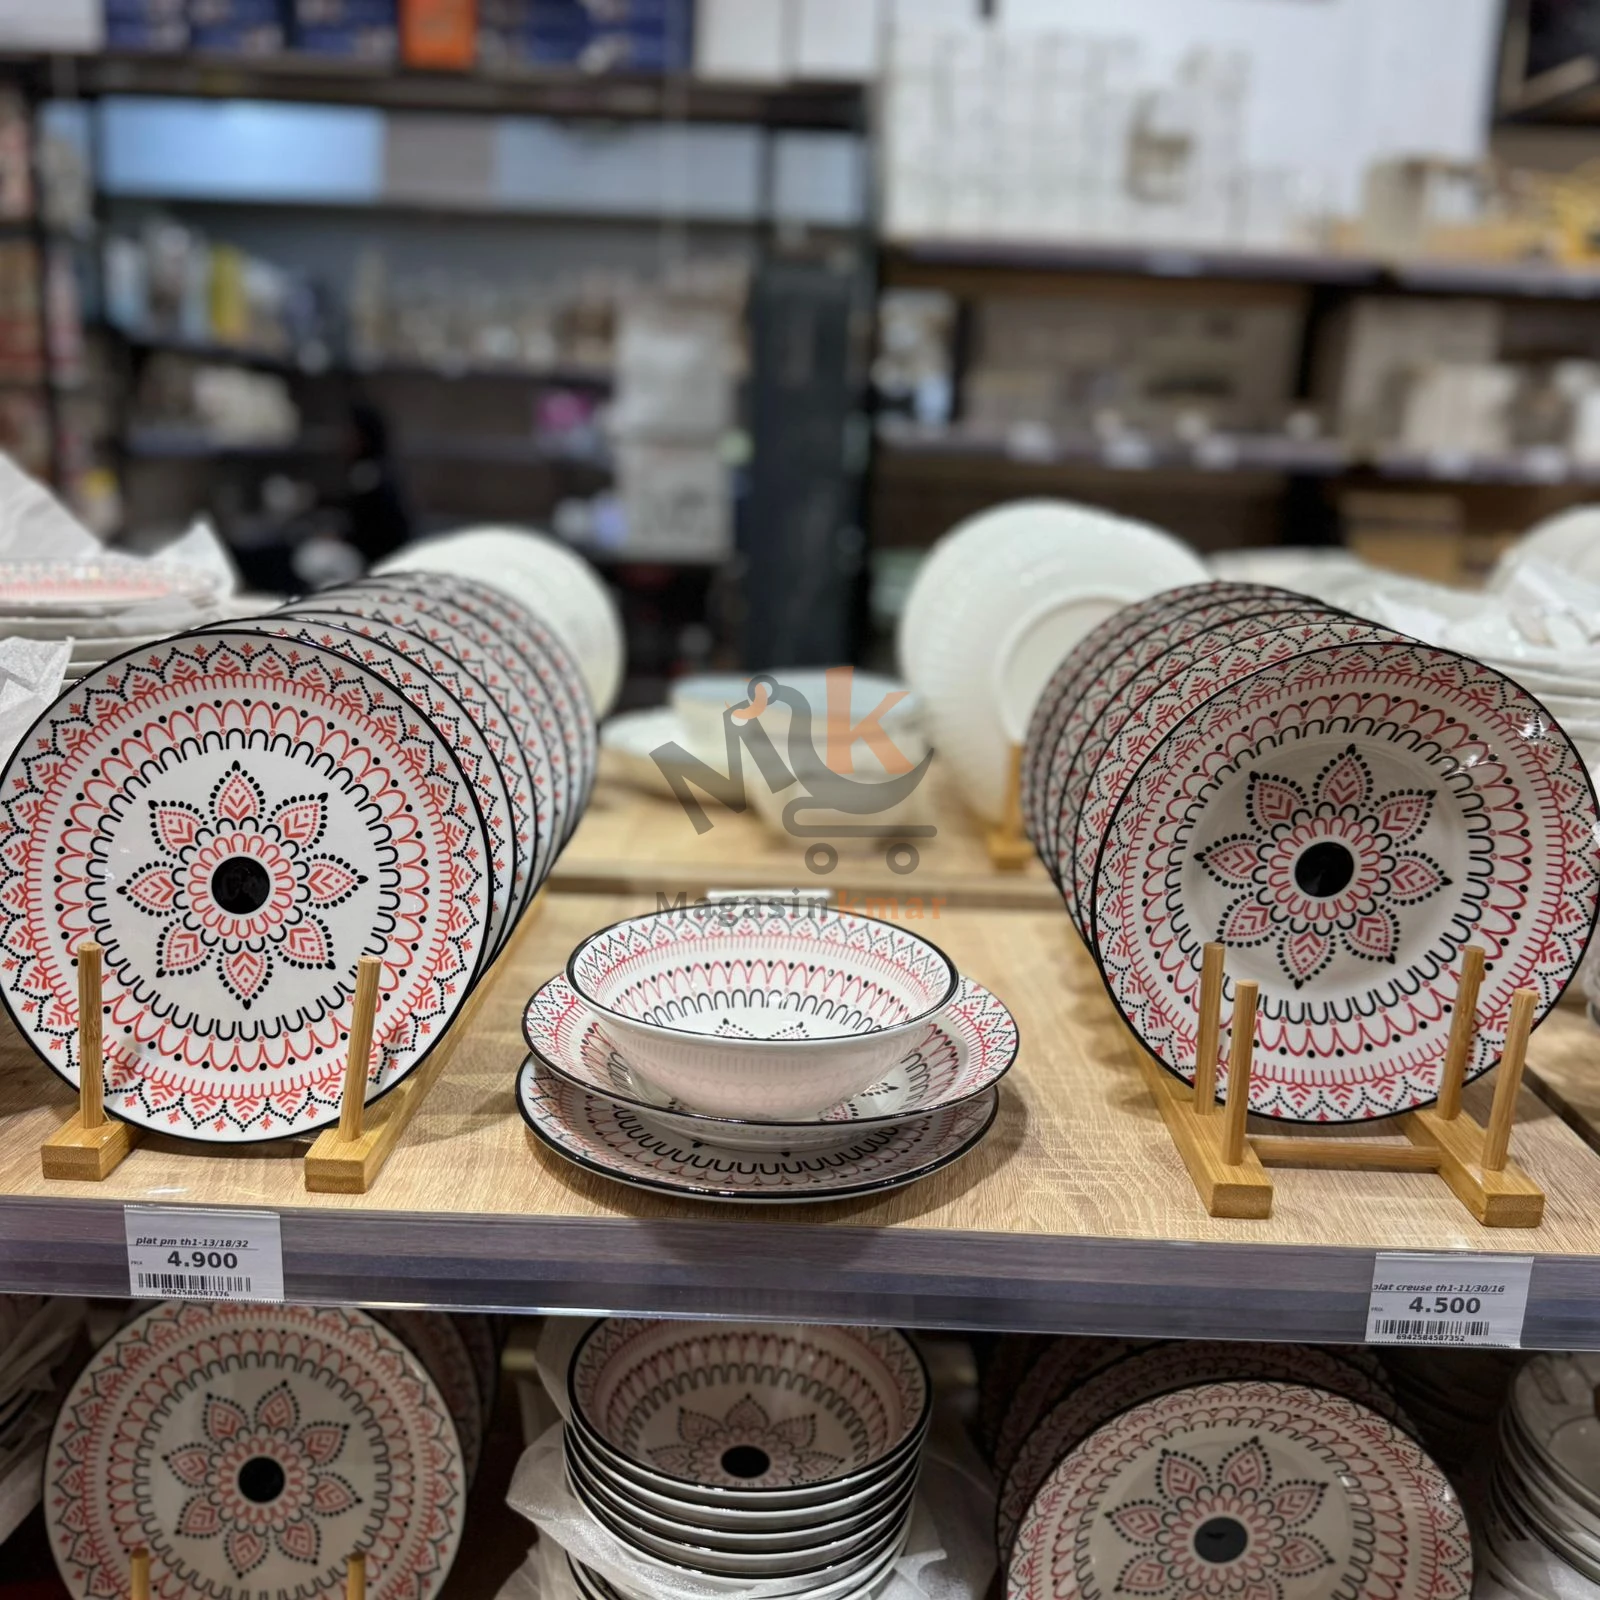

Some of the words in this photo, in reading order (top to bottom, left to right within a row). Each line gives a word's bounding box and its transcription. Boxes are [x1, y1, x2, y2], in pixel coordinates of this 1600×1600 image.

[135, 1237, 157, 1247] plat
[159, 1238, 177, 1247] pm
[180, 1238, 249, 1248] th1-13/18/32
[167, 1250, 238, 1269] 4.900
[1396, 1284, 1433, 1292] creuse
[1435, 1284, 1505, 1293] th1-11/30/16
[1408, 1296, 1481, 1314] 4.500
[1396, 1333, 1465, 1342] 6942584587352
